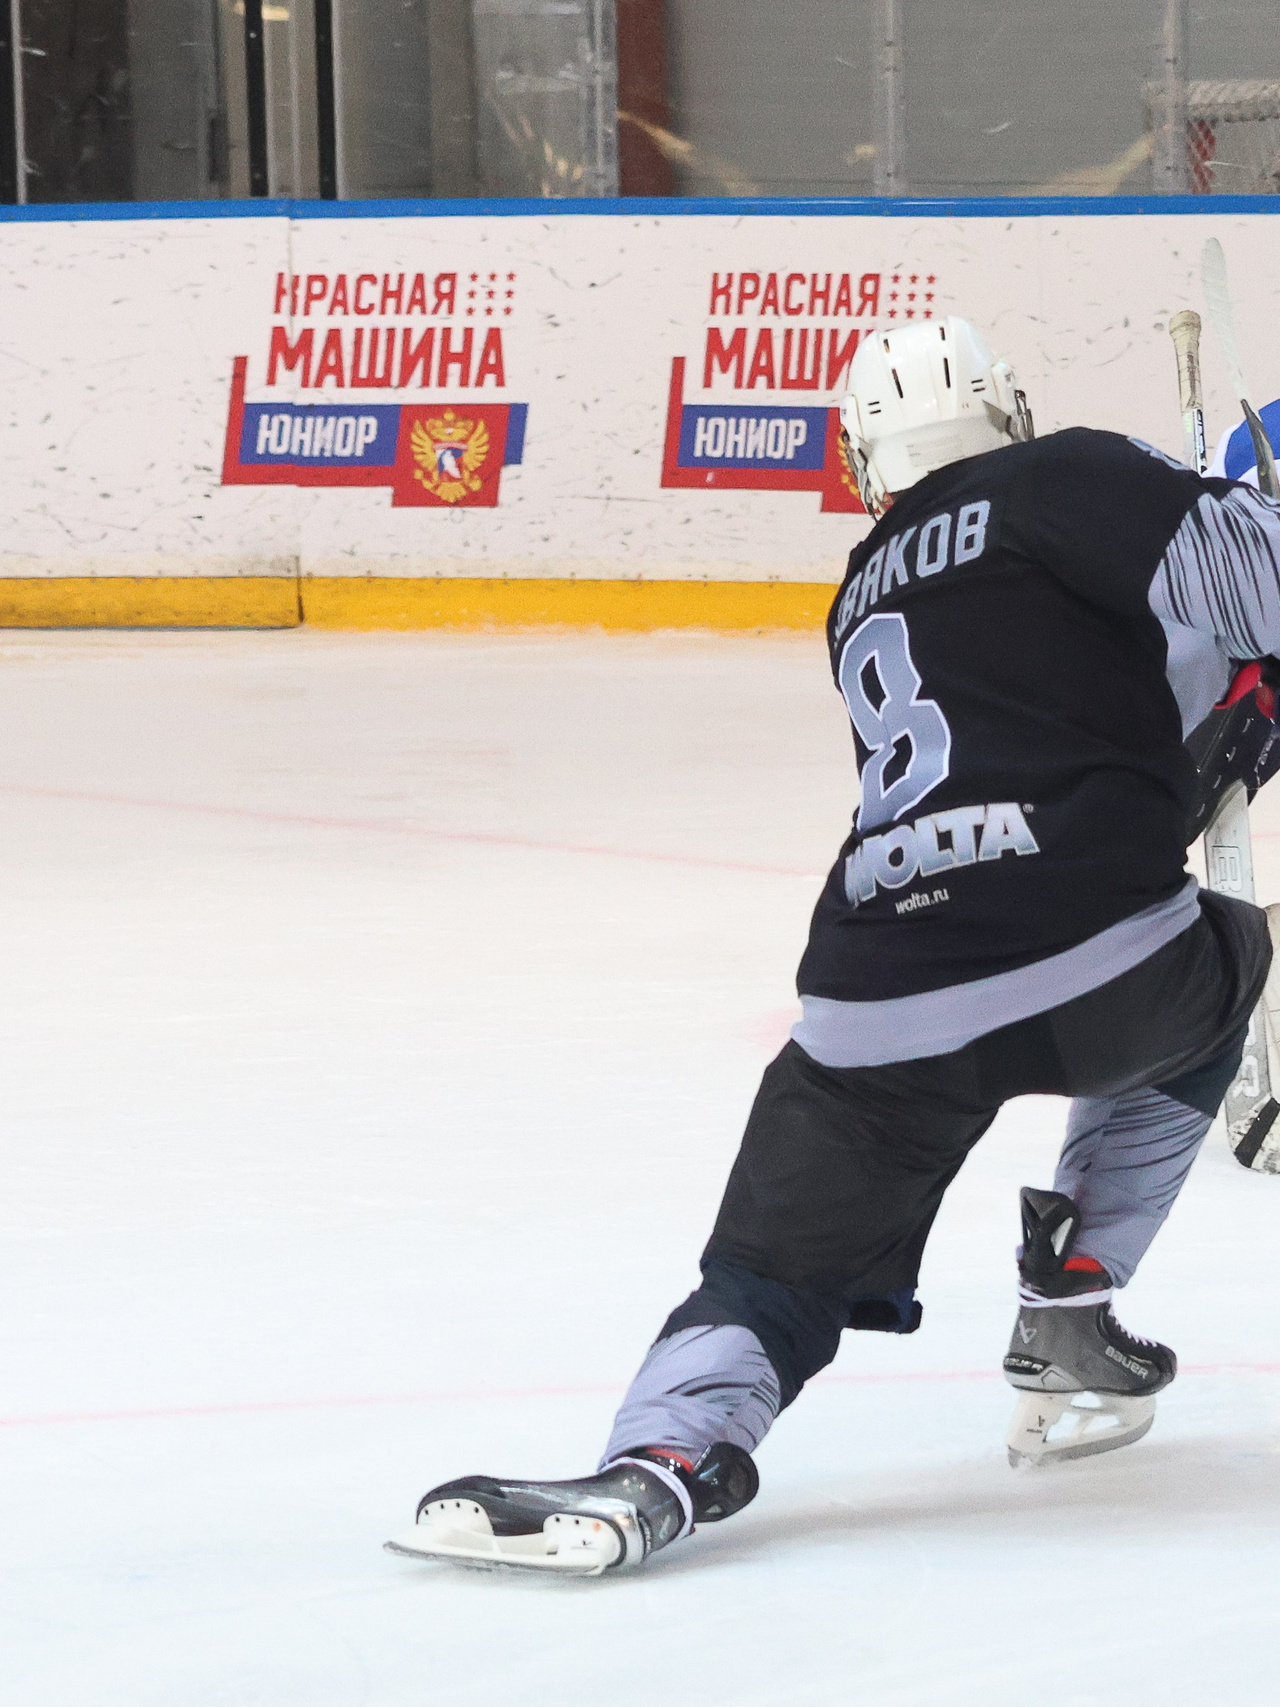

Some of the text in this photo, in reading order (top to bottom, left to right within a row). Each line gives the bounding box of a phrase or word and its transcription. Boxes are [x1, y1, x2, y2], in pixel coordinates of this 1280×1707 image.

[273, 272, 458, 316] КРАСНАЯ
[709, 272, 881, 317] КРАСНАЯ
[266, 326, 506, 388] МАШИНА
[702, 327, 876, 391] МАШИ
[256, 414, 378, 458] ЮНИОР
[693, 416, 807, 460] ЮНИОР
[839, 613, 951, 833] 8
[895, 888, 950, 914] wolta.ru
